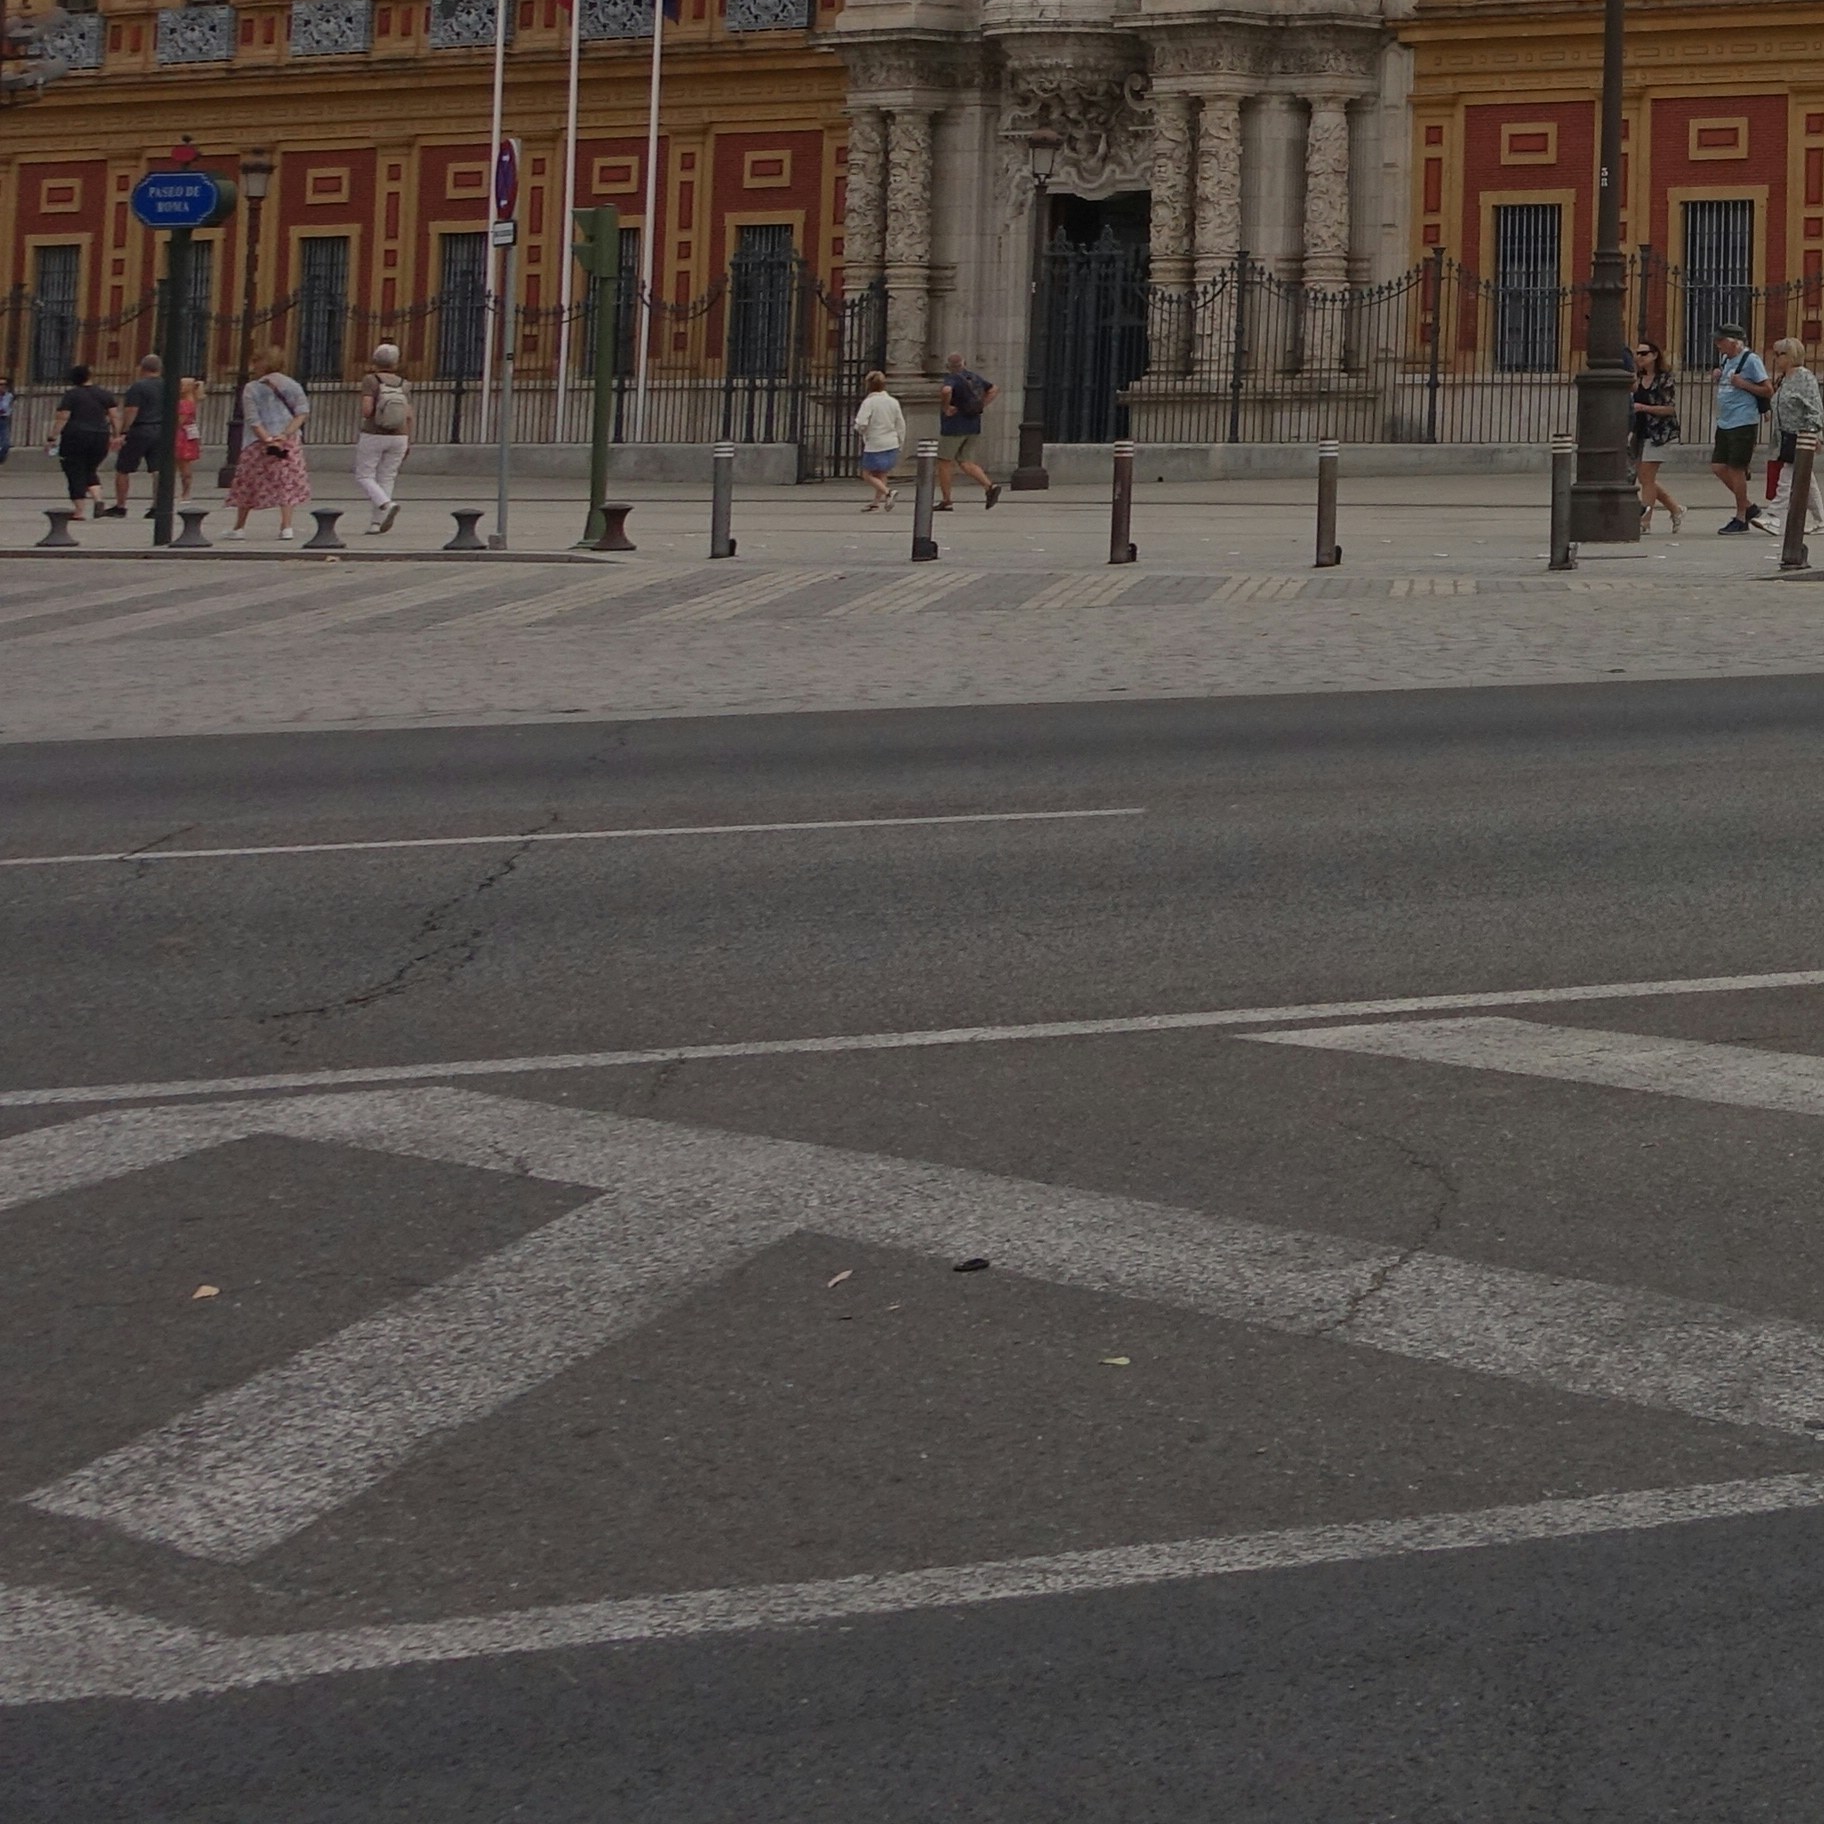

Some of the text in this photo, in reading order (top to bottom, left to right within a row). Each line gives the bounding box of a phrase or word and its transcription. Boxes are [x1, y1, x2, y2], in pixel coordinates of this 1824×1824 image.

[148, 185, 201, 197] PASEO DE
[157, 201, 190, 212] ROMA
